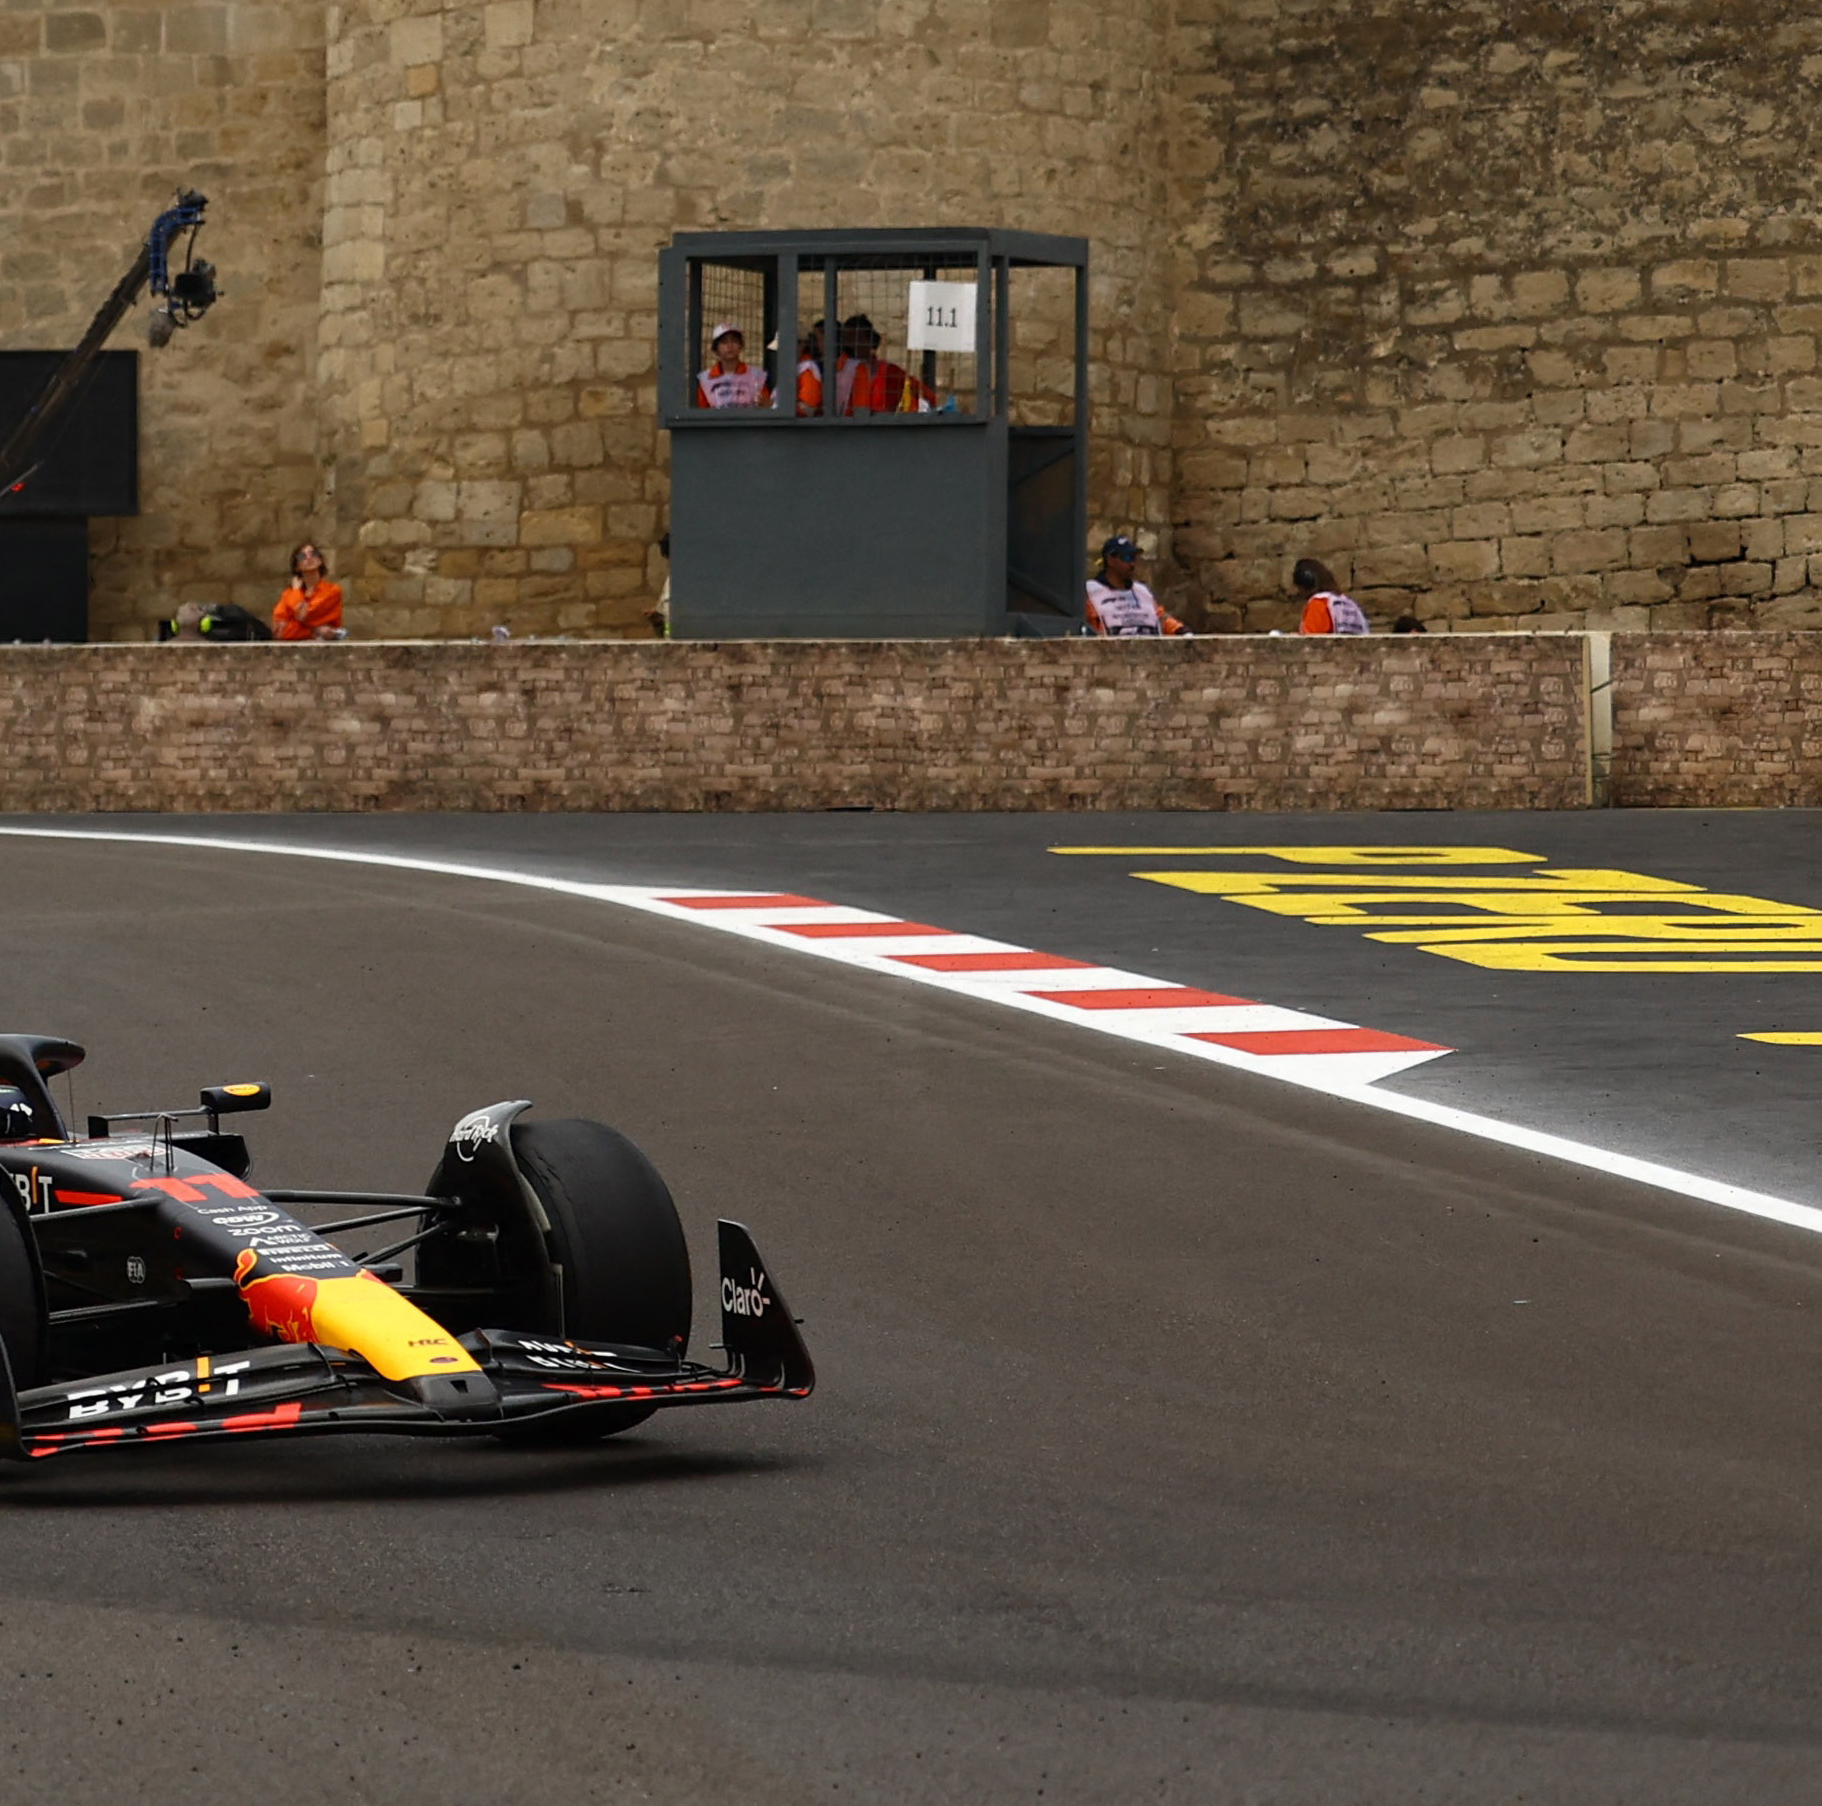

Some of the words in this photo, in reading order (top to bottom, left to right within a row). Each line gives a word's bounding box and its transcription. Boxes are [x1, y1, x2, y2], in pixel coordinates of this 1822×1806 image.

[926, 306, 958, 328] 11.1
[130, 1173, 260, 1202] 11
[197, 1206, 235, 1215] Cash
[212, 1214, 266, 1225] CDW
[227, 1224, 301, 1236] zoom
[281, 1260, 335, 1272] Mobil
[721, 1274, 767, 1317] Claro
